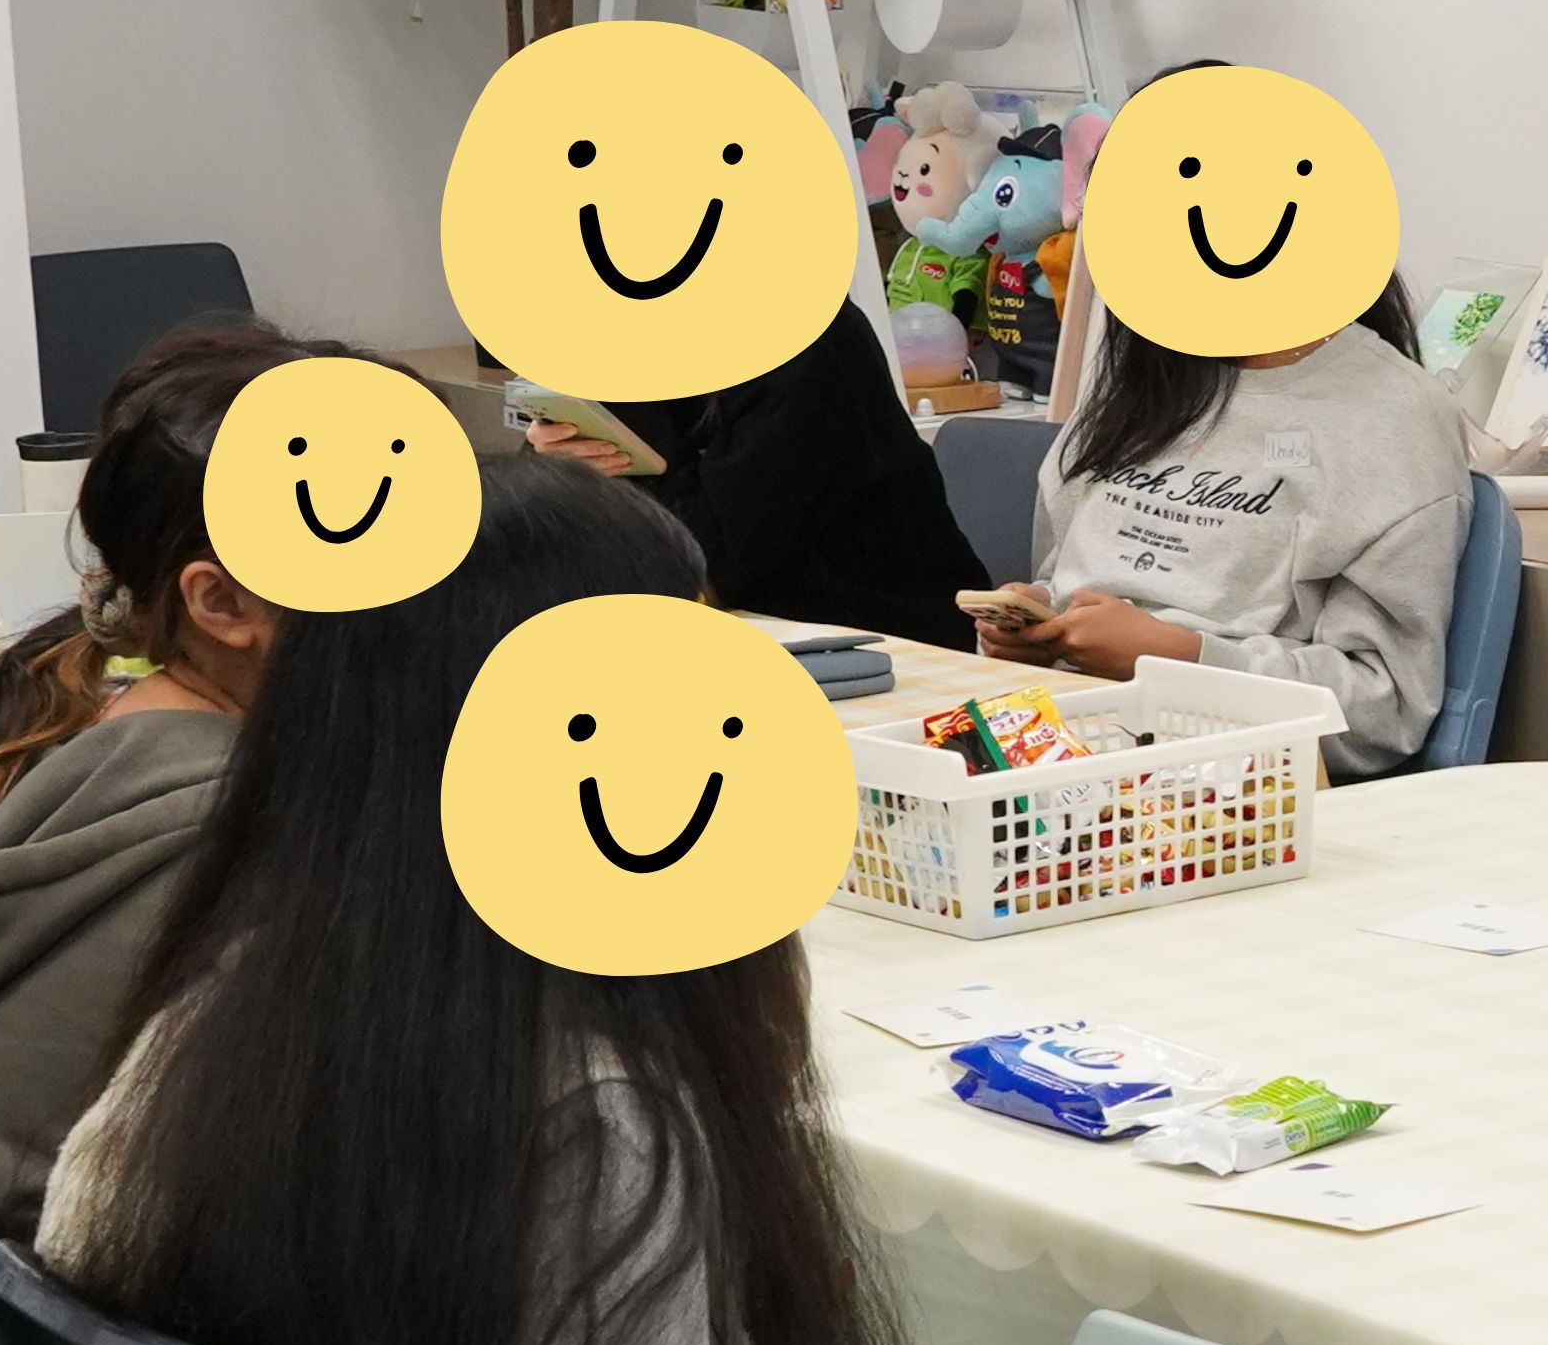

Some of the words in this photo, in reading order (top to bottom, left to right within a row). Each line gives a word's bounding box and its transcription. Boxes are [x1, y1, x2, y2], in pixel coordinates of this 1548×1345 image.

[1105, 492, 1128, 507] THE
[1133, 500, 1191, 525] SEASIDE
[1195, 516, 1225, 529] CITY
[1166, 470, 1284, 515] Island
